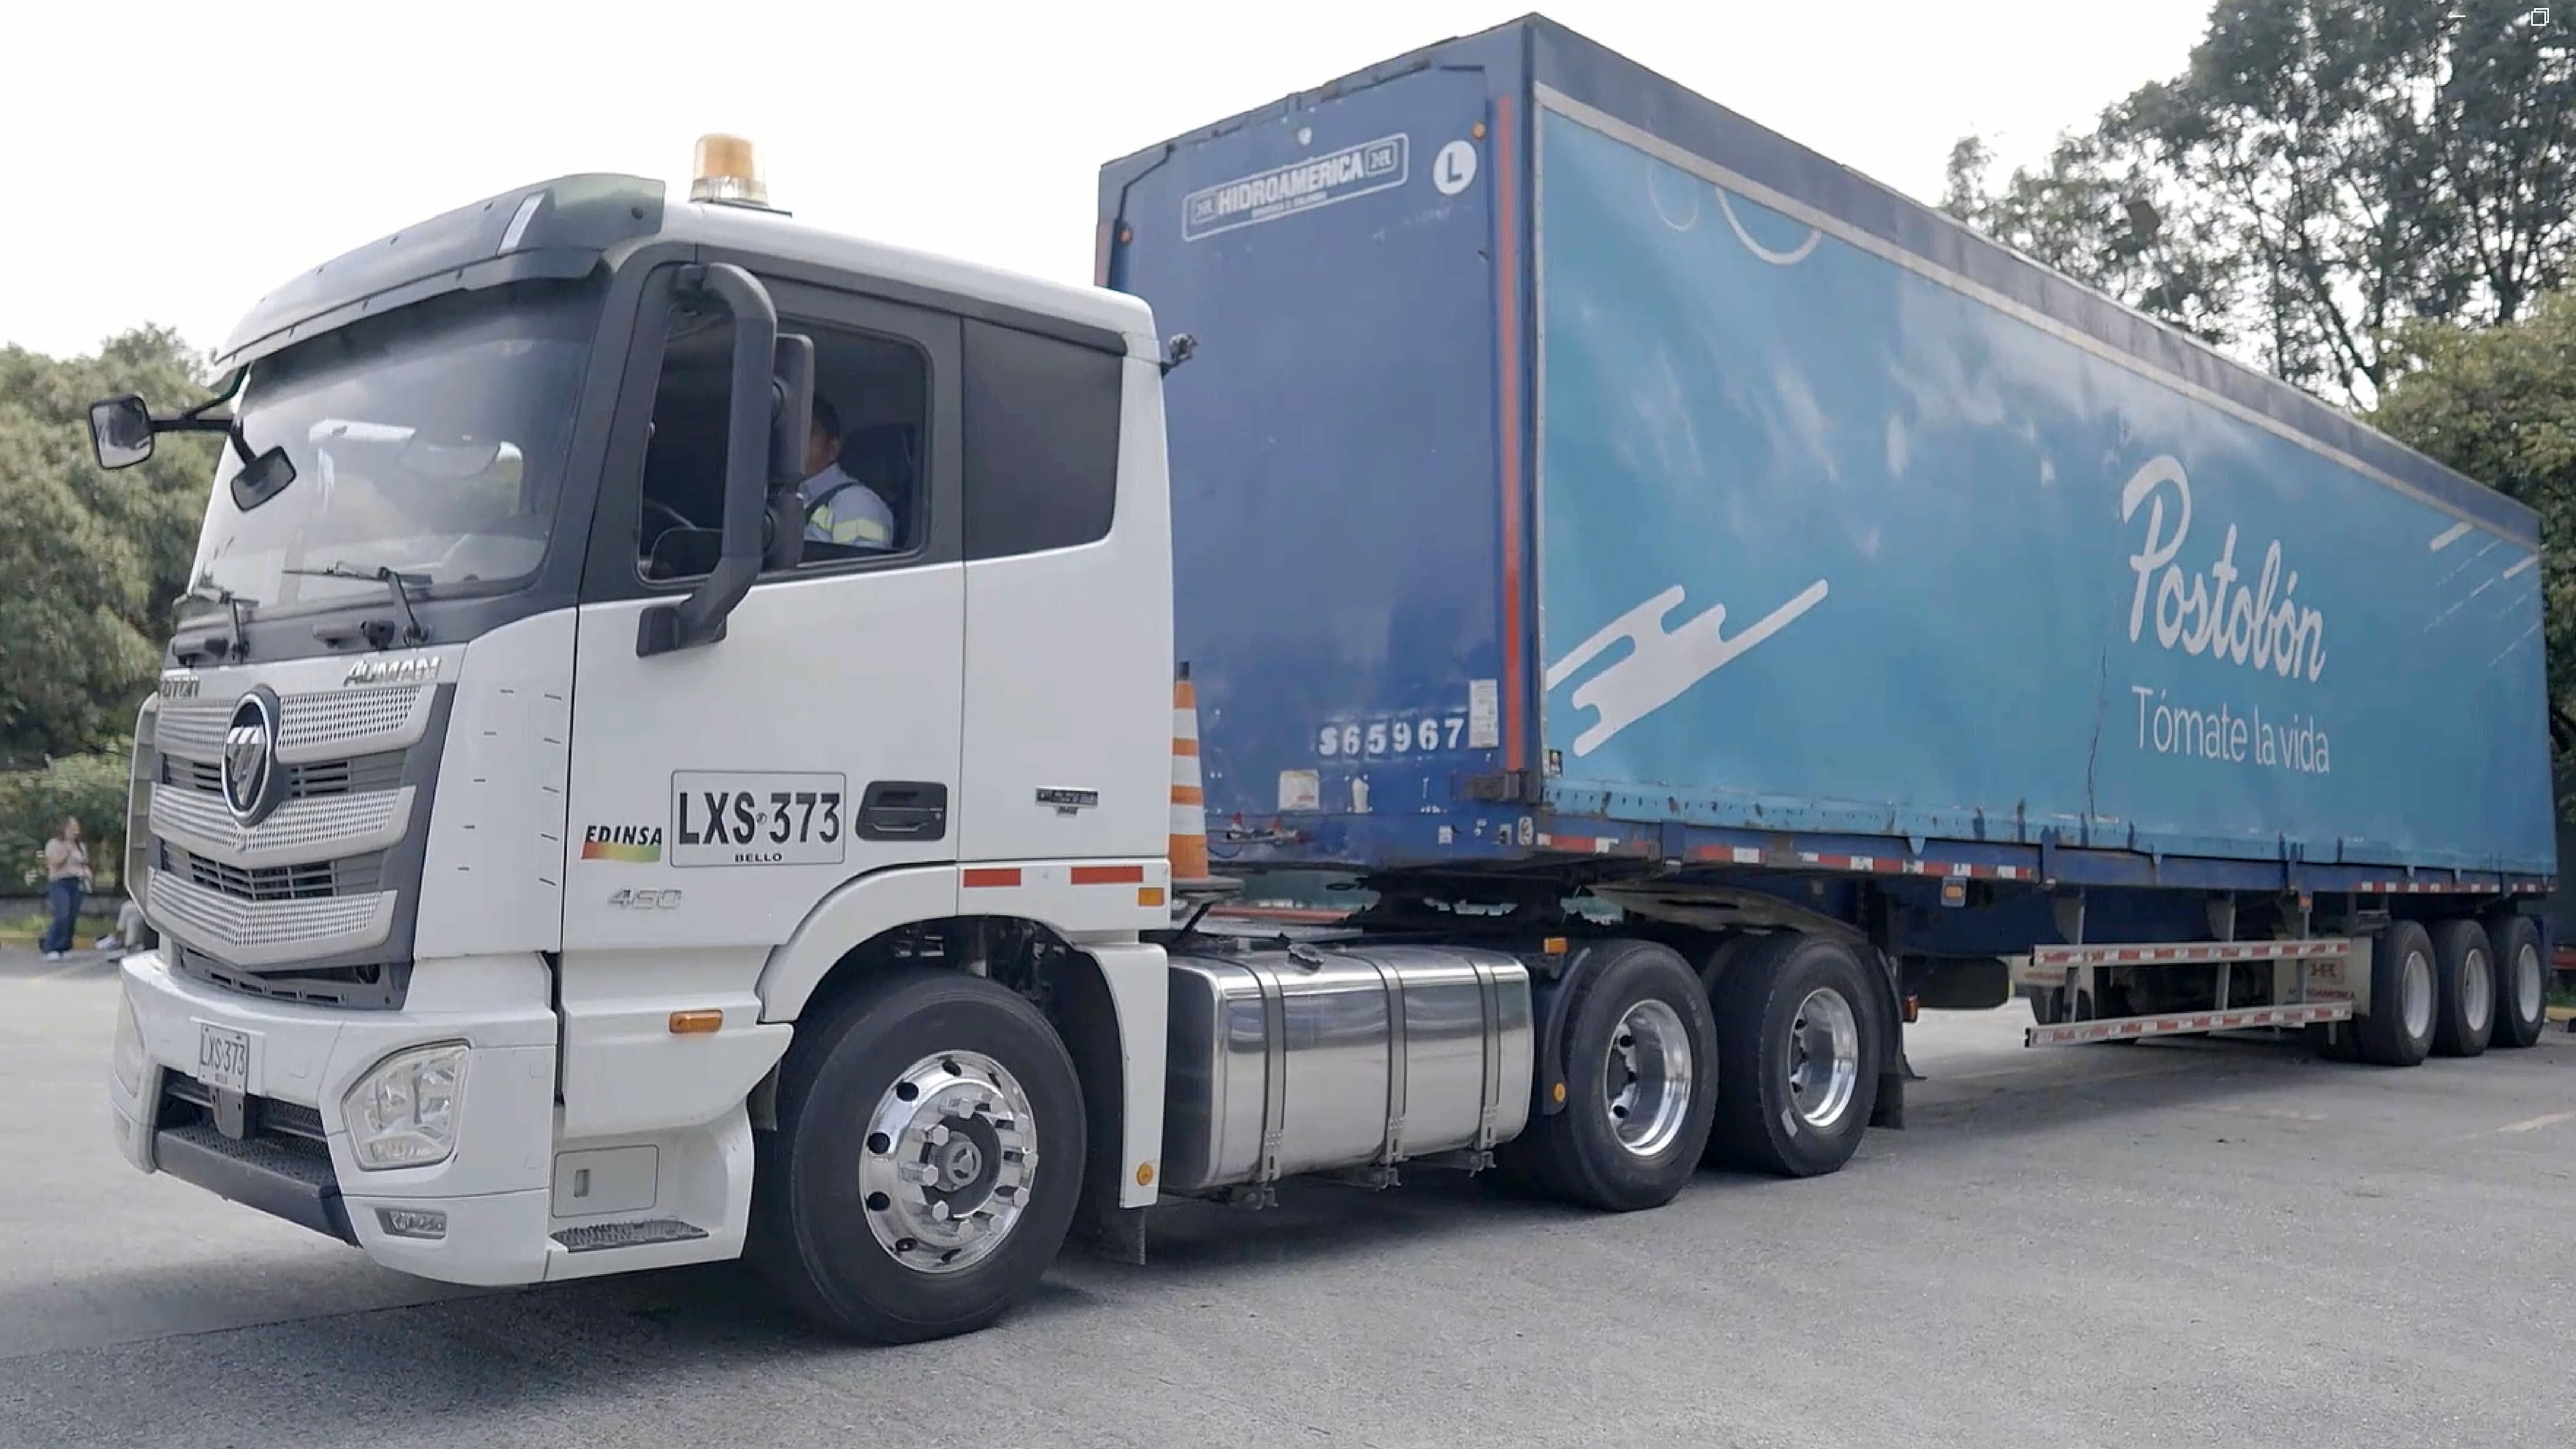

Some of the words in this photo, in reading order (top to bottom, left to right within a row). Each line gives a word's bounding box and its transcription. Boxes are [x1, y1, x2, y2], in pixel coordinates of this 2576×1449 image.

[1217, 151, 1364, 215] HIDROAMERICA
[1446, 151, 1463, 183] L
[2122, 454, 2327, 683] Postobón
[343, 657, 442, 688] AUMAN
[1318, 718, 1465, 756] S65967
[2132, 685, 2249, 763] Tómate
[2254, 704, 2276, 766] la
[2279, 713, 2331, 775] vida
[585, 825, 663, 846] EDINSA
